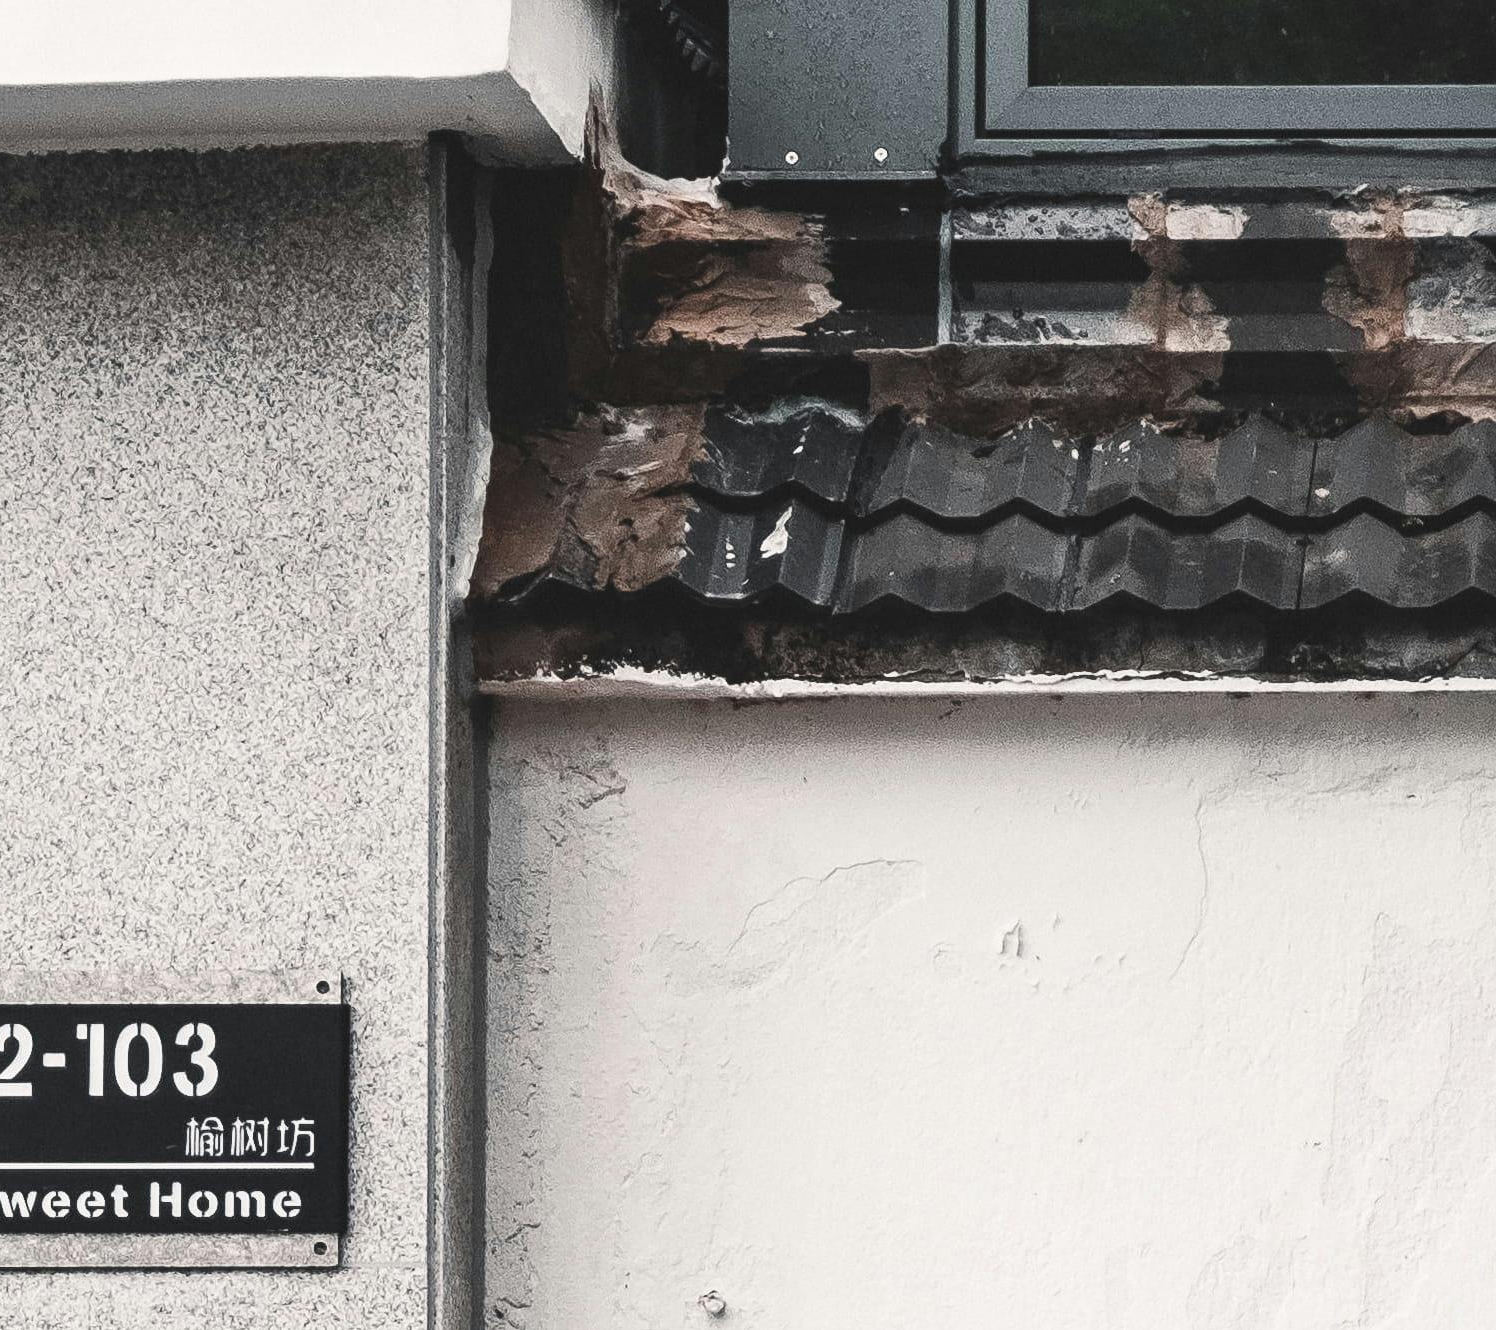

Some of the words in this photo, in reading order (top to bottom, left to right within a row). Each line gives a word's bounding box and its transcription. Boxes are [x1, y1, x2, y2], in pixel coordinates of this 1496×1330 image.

[185, 1116, 316, 1157] 榆树坊
[149, 1180, 303, 1219] Home
